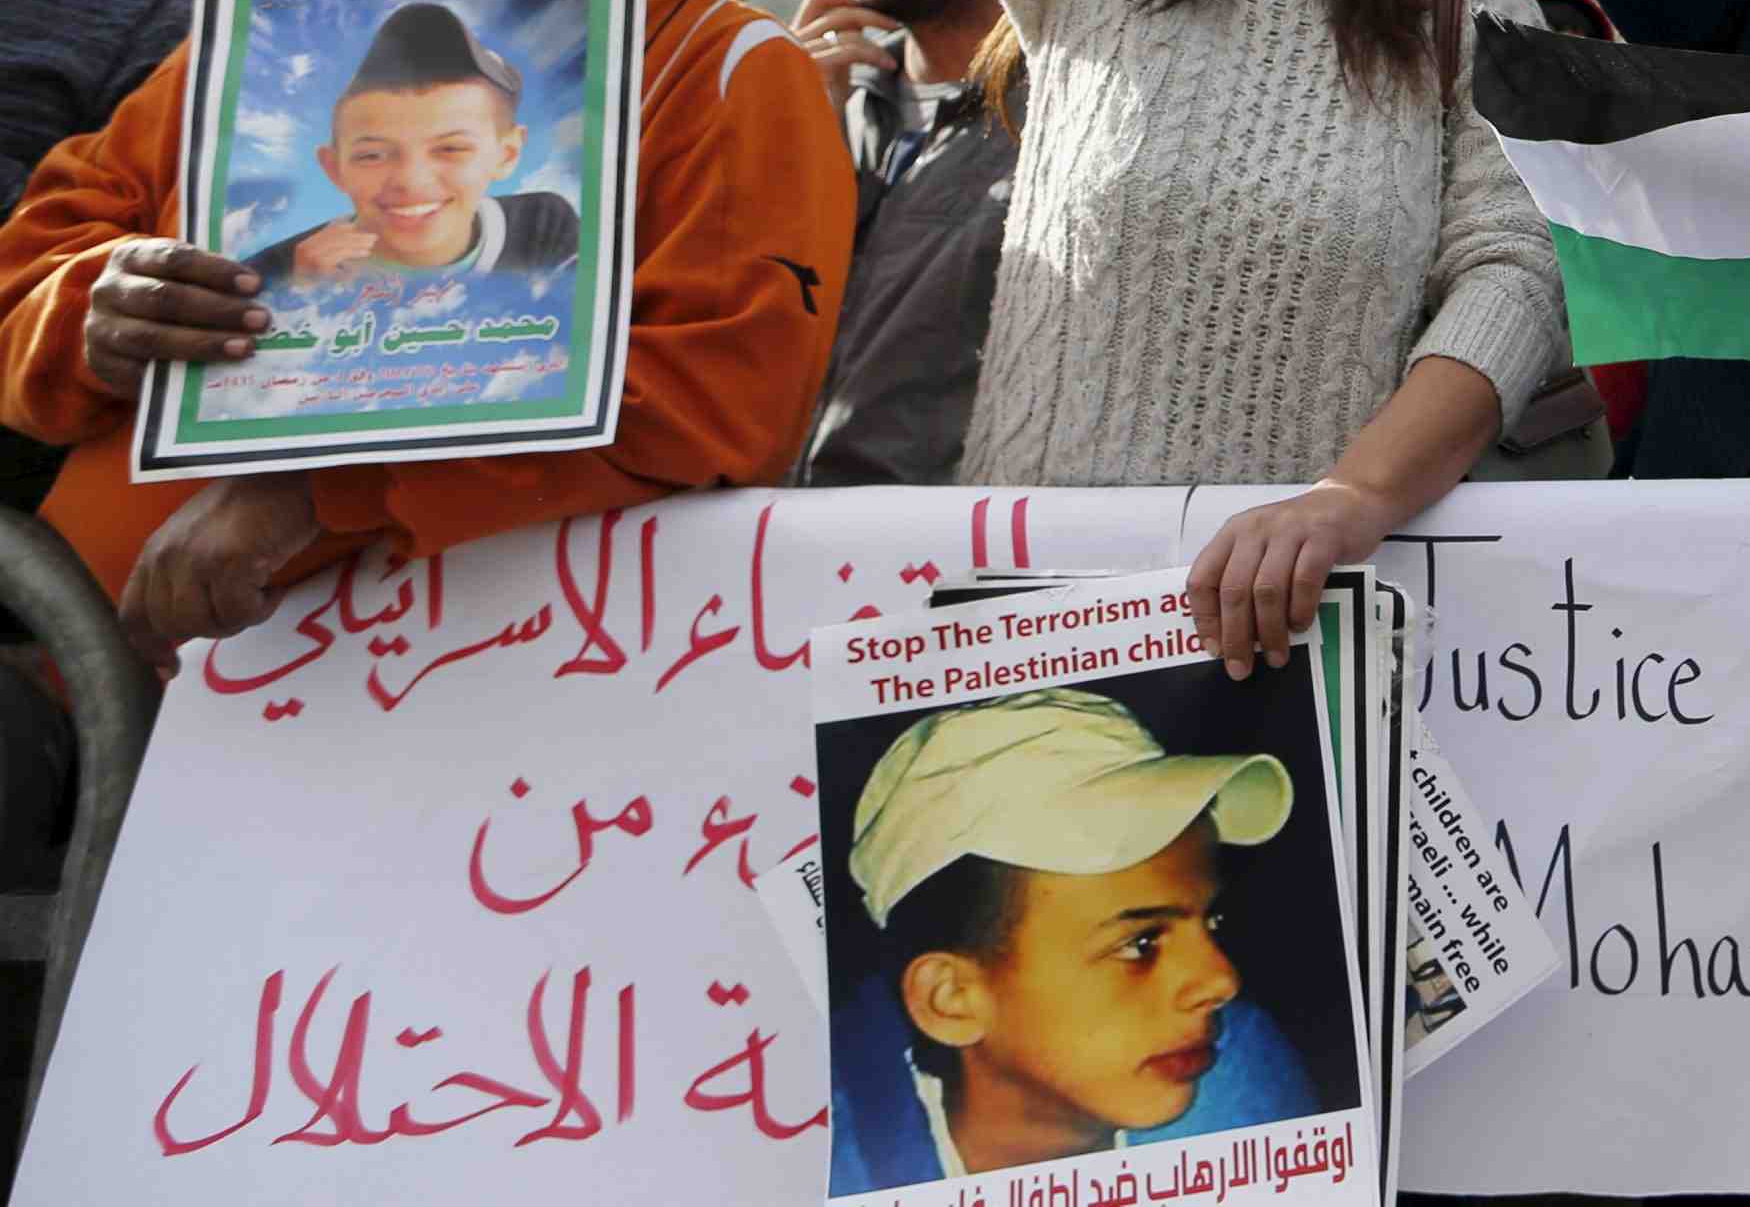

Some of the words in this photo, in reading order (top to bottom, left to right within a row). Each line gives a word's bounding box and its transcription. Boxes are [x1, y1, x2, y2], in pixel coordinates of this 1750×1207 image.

[382, 318, 468, 354] حسين
[475, 315, 560, 343] محمد
[846, 630, 926, 664] Stop
[932, 620, 994, 653] The
[1000, 596, 1151, 642] Terrorism
[1383, 534, 1714, 725] Justice
[870, 675, 936, 706] The
[943, 645, 1120, 695] Palestinian
[468, 775, 654, 916] من
[1411, 766, 1481, 870] children
[1475, 870, 1509, 913] are
[1441, 938, 1481, 994] free
[1459, 904, 1510, 976] while
[152, 964, 638, 1157] الاحتلال
[1146, 1137, 1257, 1207] الارهاب
[1265, 1121, 1354, 1193] اوقفوا
